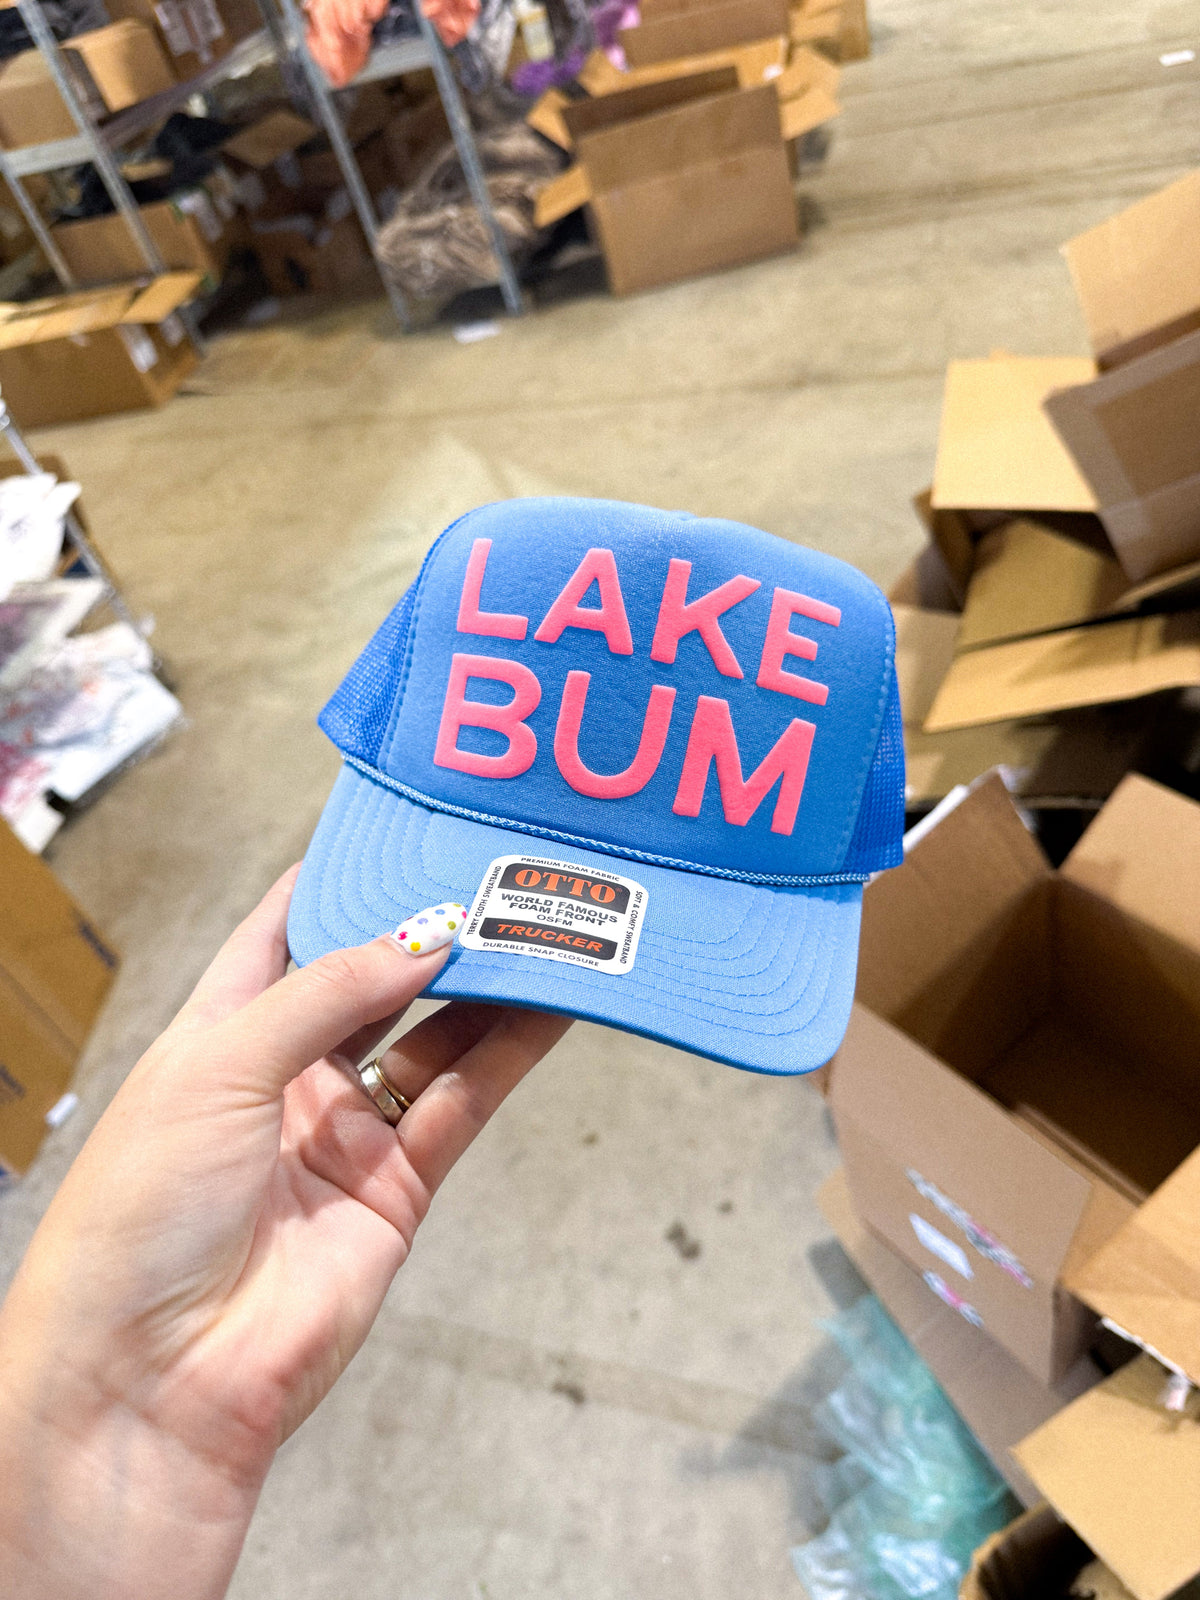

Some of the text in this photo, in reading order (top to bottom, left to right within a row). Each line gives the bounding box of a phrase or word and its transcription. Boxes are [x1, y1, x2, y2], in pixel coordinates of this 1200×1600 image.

[456, 537, 842, 706] LAKE
[433, 653, 817, 836] BUM
[520, 857, 621, 882] PREMIUM FOAM FABRIC
[466, 865, 502, 936] TERRY CLOTH SWEATBAND
[514, 869, 616, 904] OTTO
[635, 891, 643, 903] SOFT
[501, 892, 619, 924] WORLD FAMOUS
[509, 902, 606, 926] FOAM FRONT
[536, 914, 574, 927] OSFM
[628, 910, 639, 931] COMFY
[497, 924, 604, 953] TRUCKER
[620, 931, 634, 965] SWEATBAND
[482, 941, 600, 968] DURABLE SNAP CLOSURE
